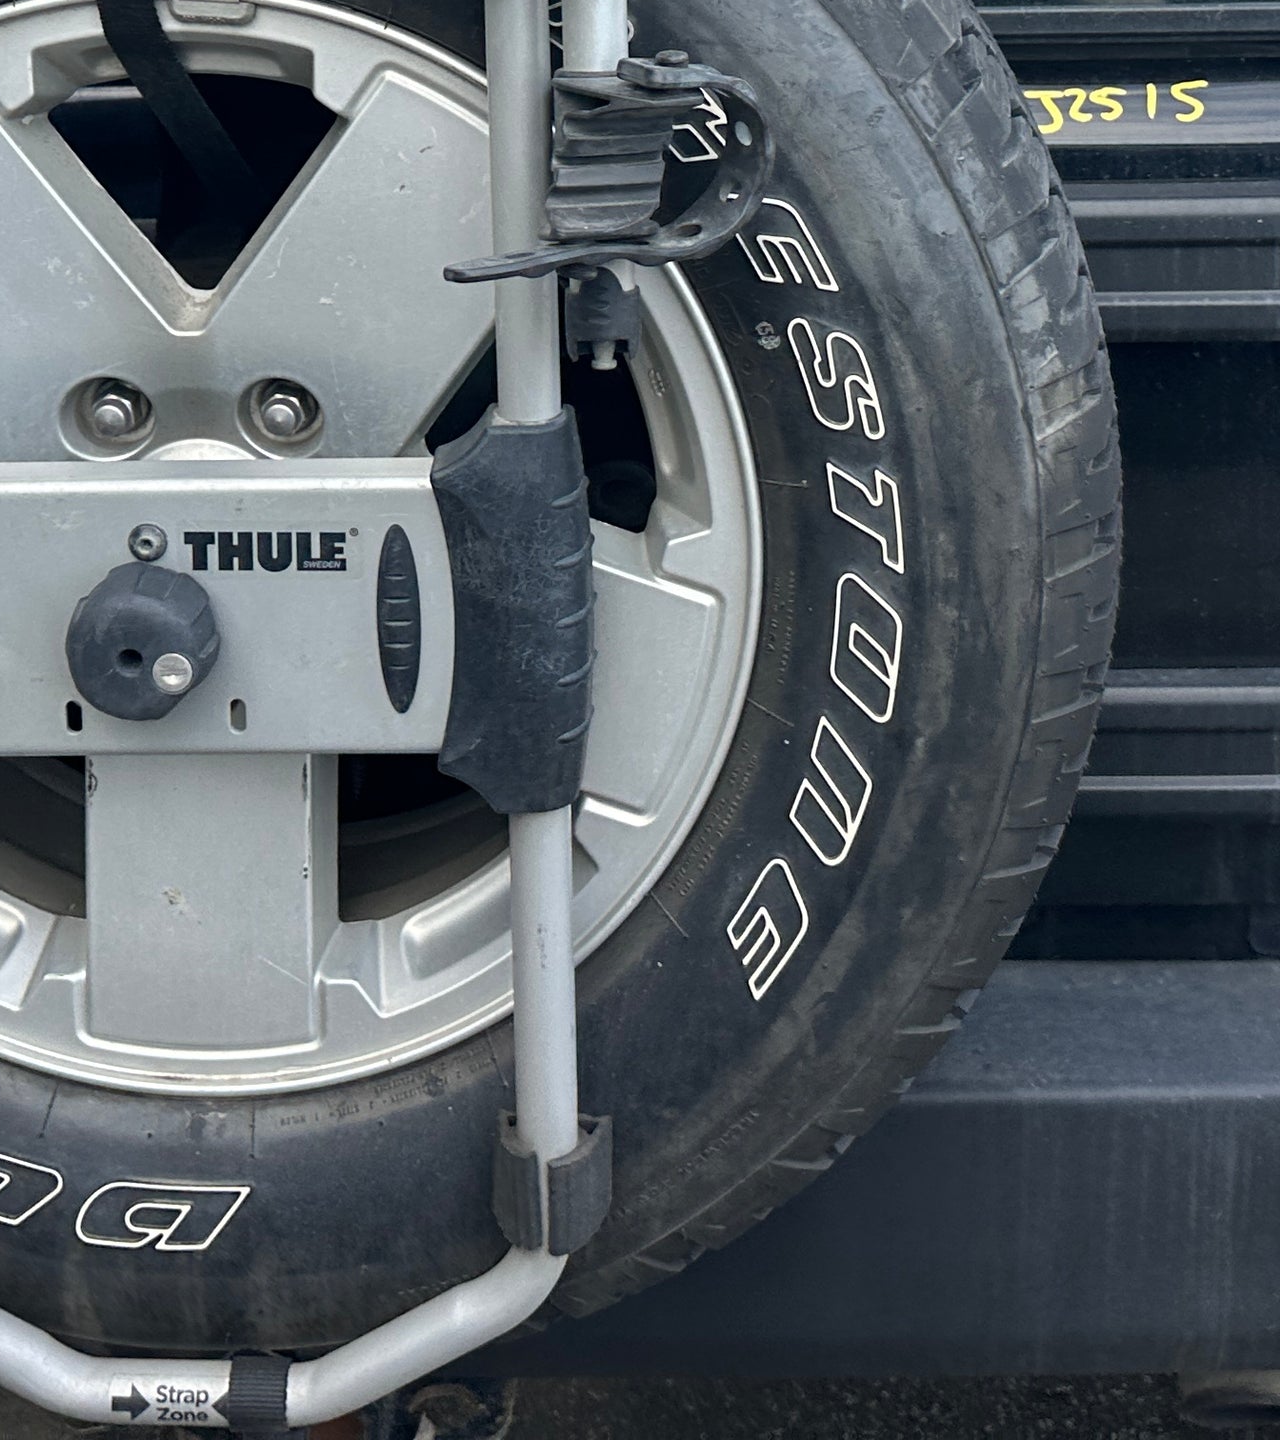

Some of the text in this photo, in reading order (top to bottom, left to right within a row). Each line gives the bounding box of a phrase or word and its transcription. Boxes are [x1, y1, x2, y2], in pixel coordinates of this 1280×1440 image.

[1023, 80, 1209, 134] J2515
[184, 531, 347, 572] THULE
[302, 560, 342, 569] SWEDEN
[156, 1384, 209, 1407] Strap
[157, 1407, 208, 1422] Zone
